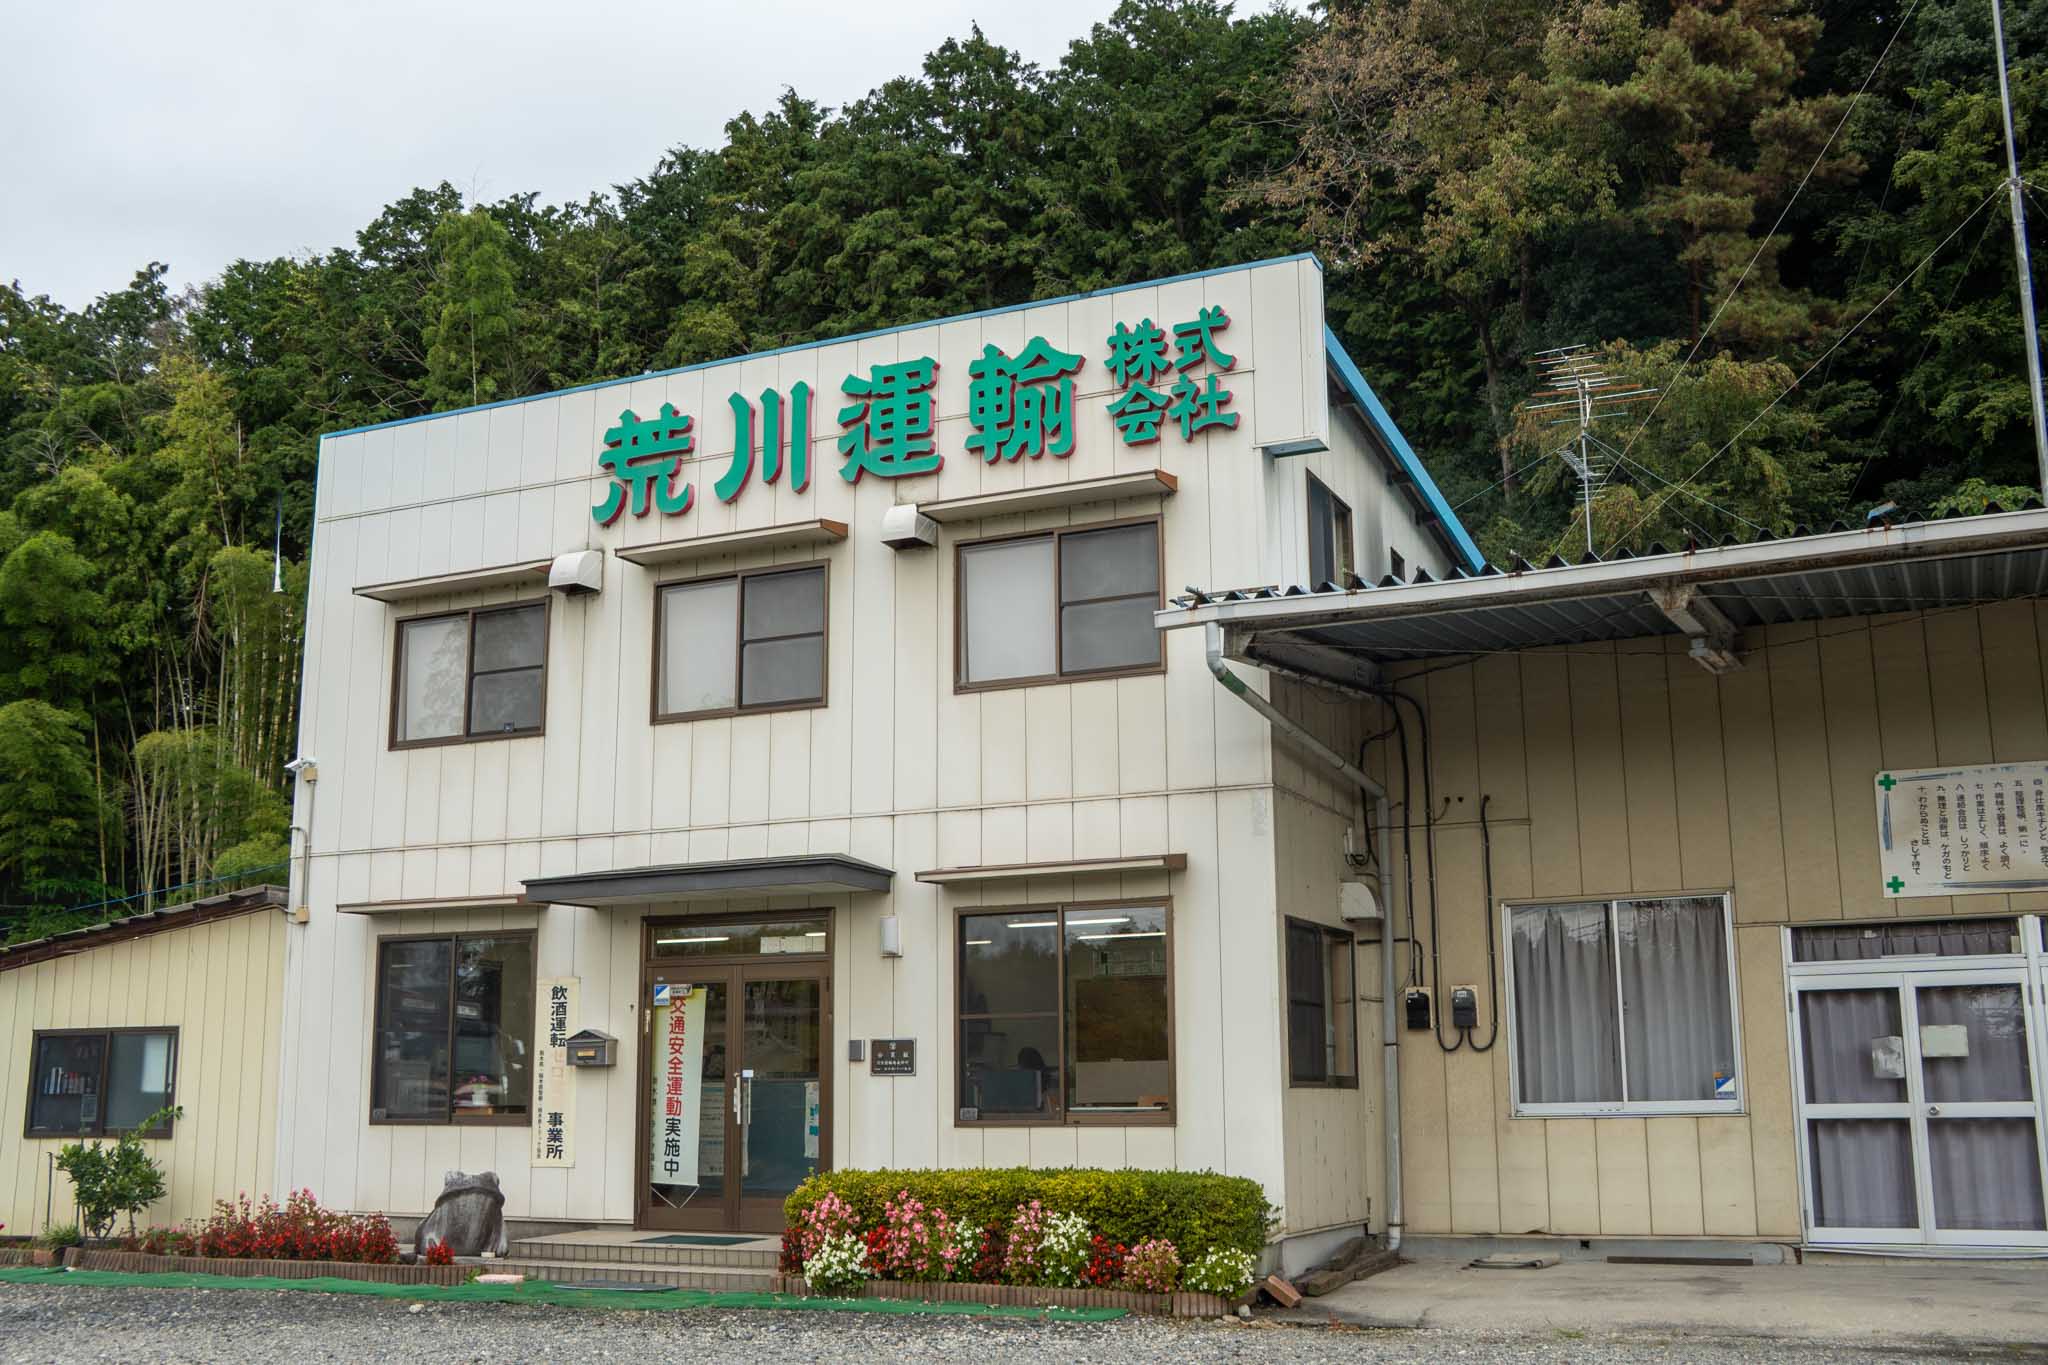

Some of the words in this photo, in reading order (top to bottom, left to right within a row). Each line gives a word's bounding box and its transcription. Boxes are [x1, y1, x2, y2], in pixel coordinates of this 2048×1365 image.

[1104, 304, 1237, 389] 株式
[592, 335, 1086, 527] 荒川運輸
[1106, 374, 1240, 446] 会社
[550, 985, 568, 1048] 飲酒運転
[663, 996, 686, 1178] 交通安全運動実施中
[546, 1111, 565, 1161] 事業所
